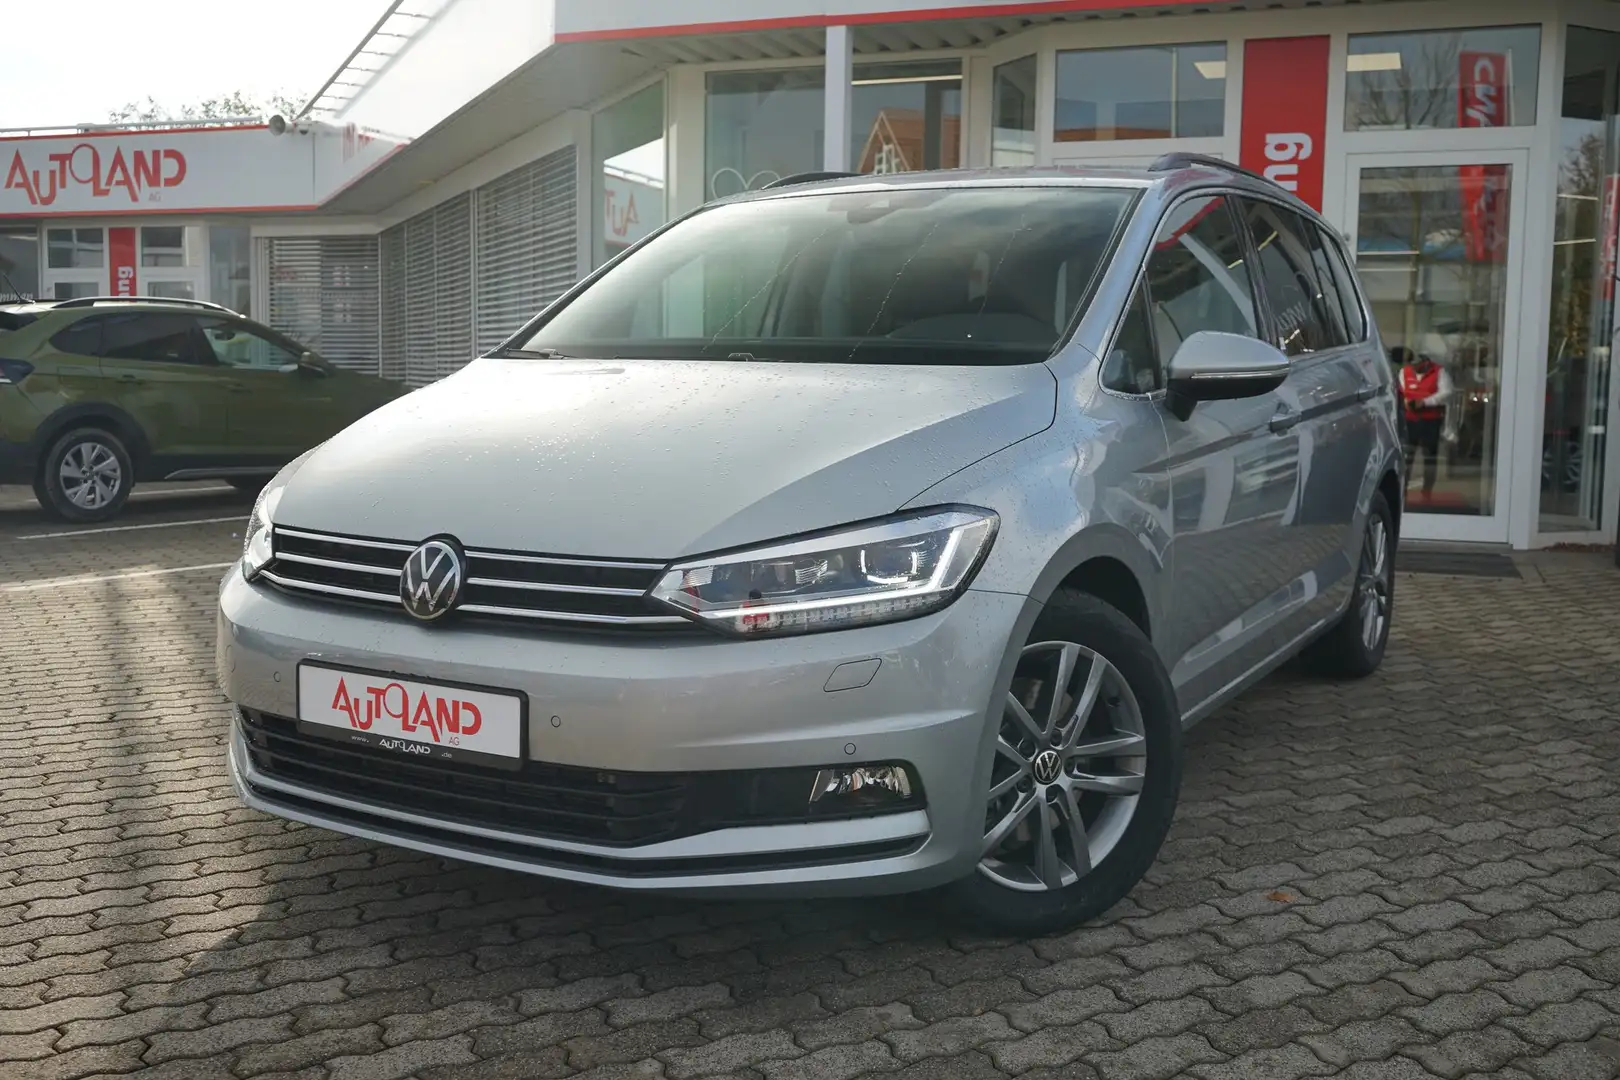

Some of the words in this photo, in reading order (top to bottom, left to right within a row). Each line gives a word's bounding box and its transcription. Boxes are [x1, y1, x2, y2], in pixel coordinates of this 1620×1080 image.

[5, 144, 187, 205] AUTOLAND
[117, 266, 133, 296] ng
[332, 677, 482, 743] AUTOLAND
